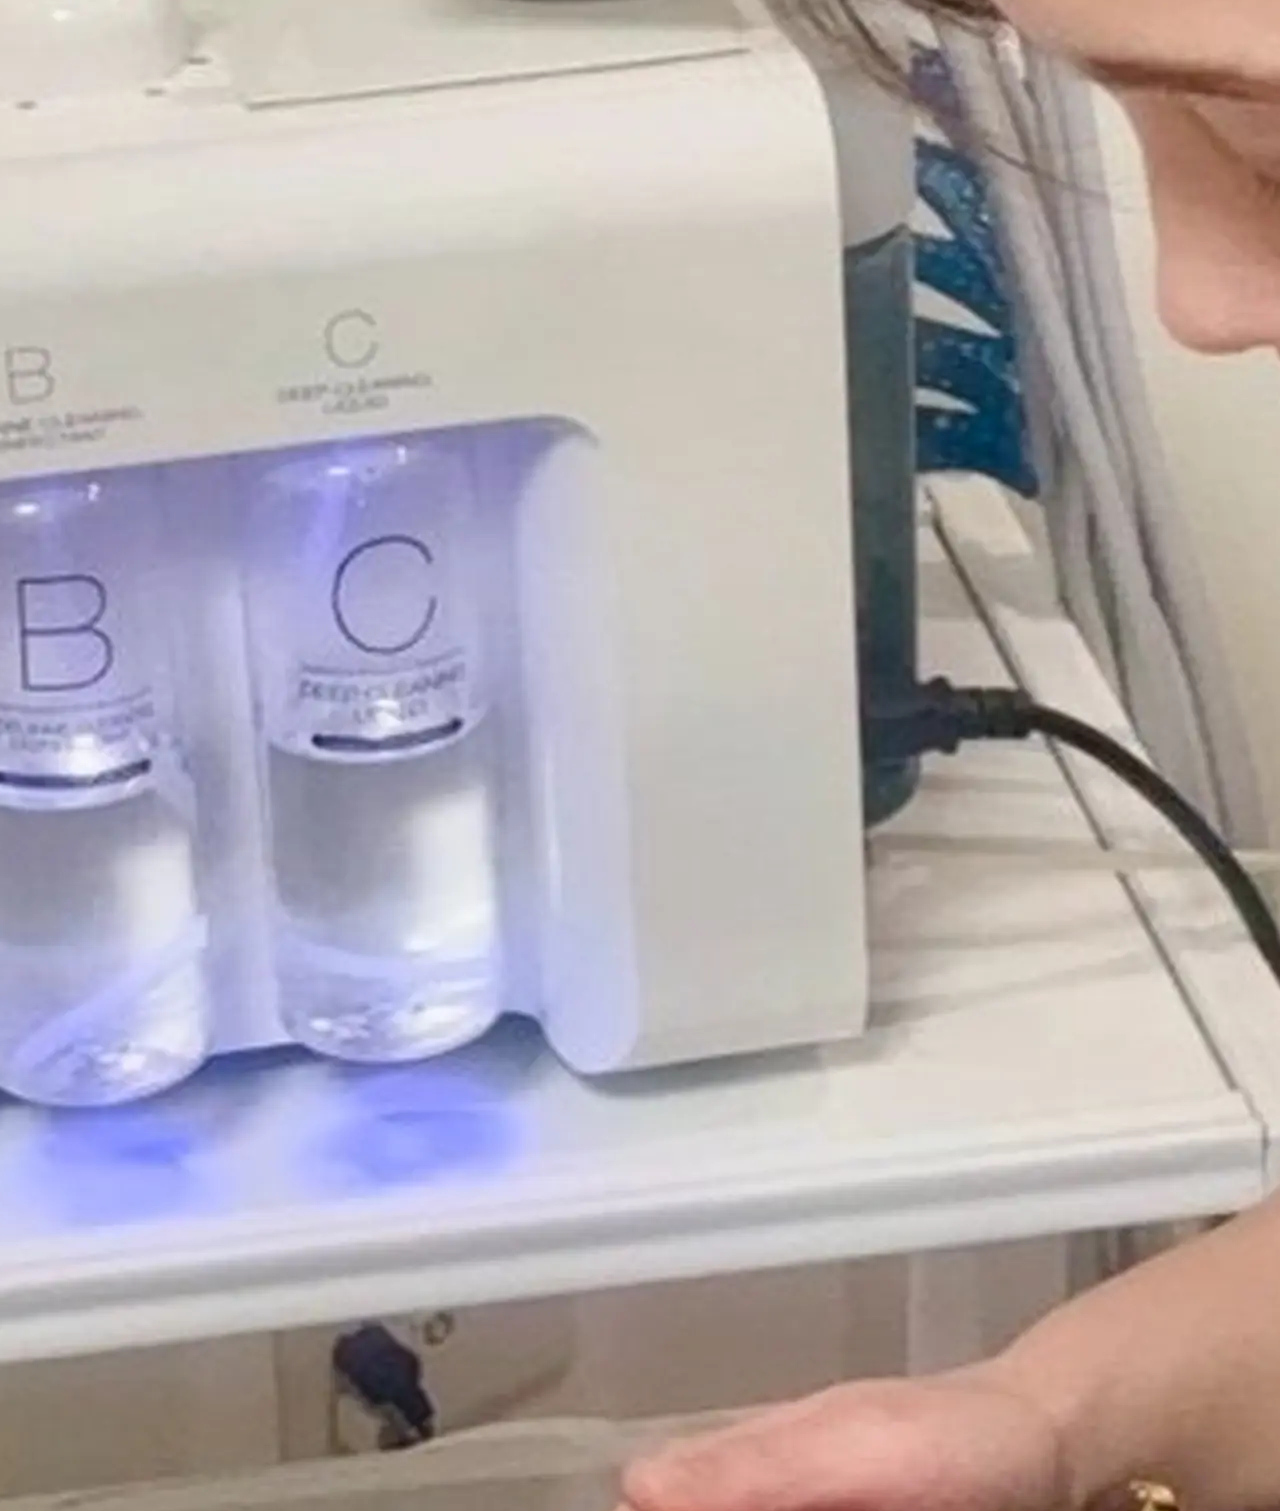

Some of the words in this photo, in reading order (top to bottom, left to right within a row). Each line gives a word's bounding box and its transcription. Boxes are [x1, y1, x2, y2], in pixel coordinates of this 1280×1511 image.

[5, 345, 55, 405] B
[324, 307, 379, 369] C
[16, 573, 114, 692] B
[331, 533, 437, 655] C
